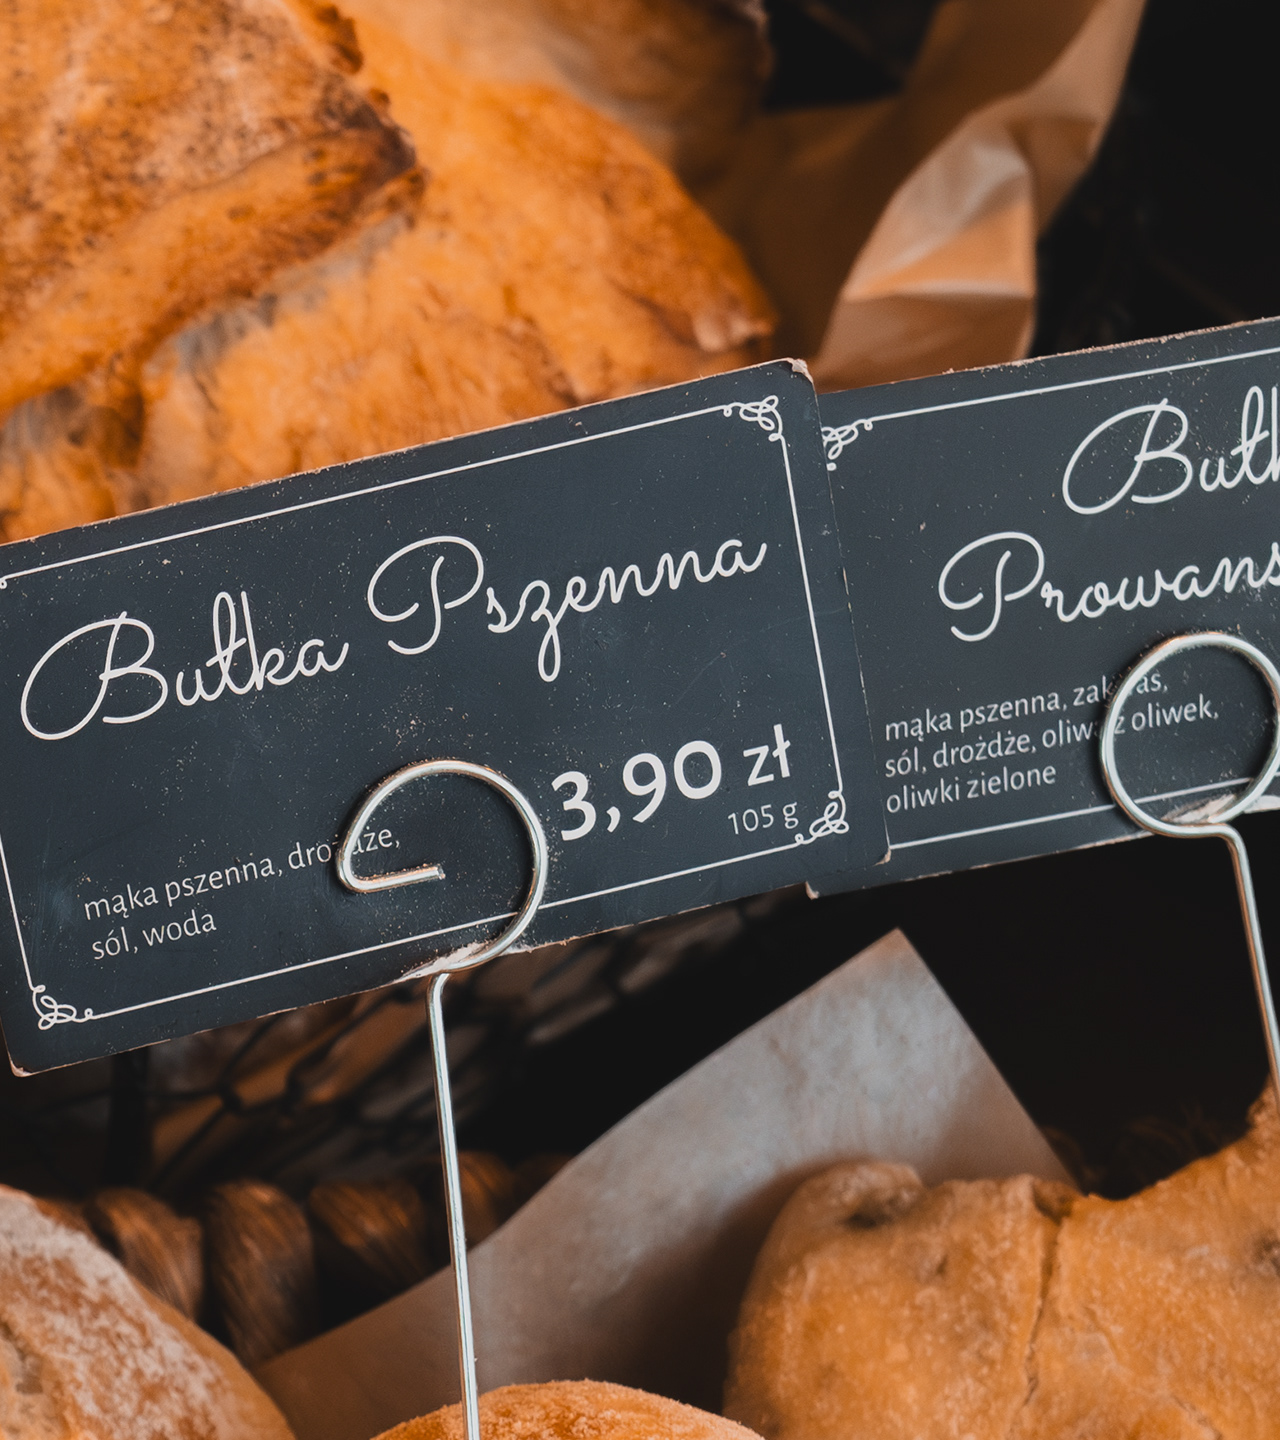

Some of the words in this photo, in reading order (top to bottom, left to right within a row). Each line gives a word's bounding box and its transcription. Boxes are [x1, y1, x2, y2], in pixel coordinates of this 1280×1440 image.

[366, 534, 768, 683] Pszenna
[884, 747, 927, 781] sól,
[932, 730, 1037, 769] drożdże,
[1130, 693, 1219, 732] oliwek,
[885, 710, 953, 742] mąka
[959, 688, 1068, 728] pszenna,
[550, 740, 722, 842] 3,90
[742, 723, 791, 786] zł
[885, 773, 960, 815] oliwki
[966, 763, 1057, 800] zielone
[727, 803, 775, 835] 105
[782, 802, 800, 830] g
[84, 883, 159, 922] mąka
[164, 856, 282, 906] pszenna,
[91, 926, 139, 962] sól,
[141, 909, 218, 948] woda
